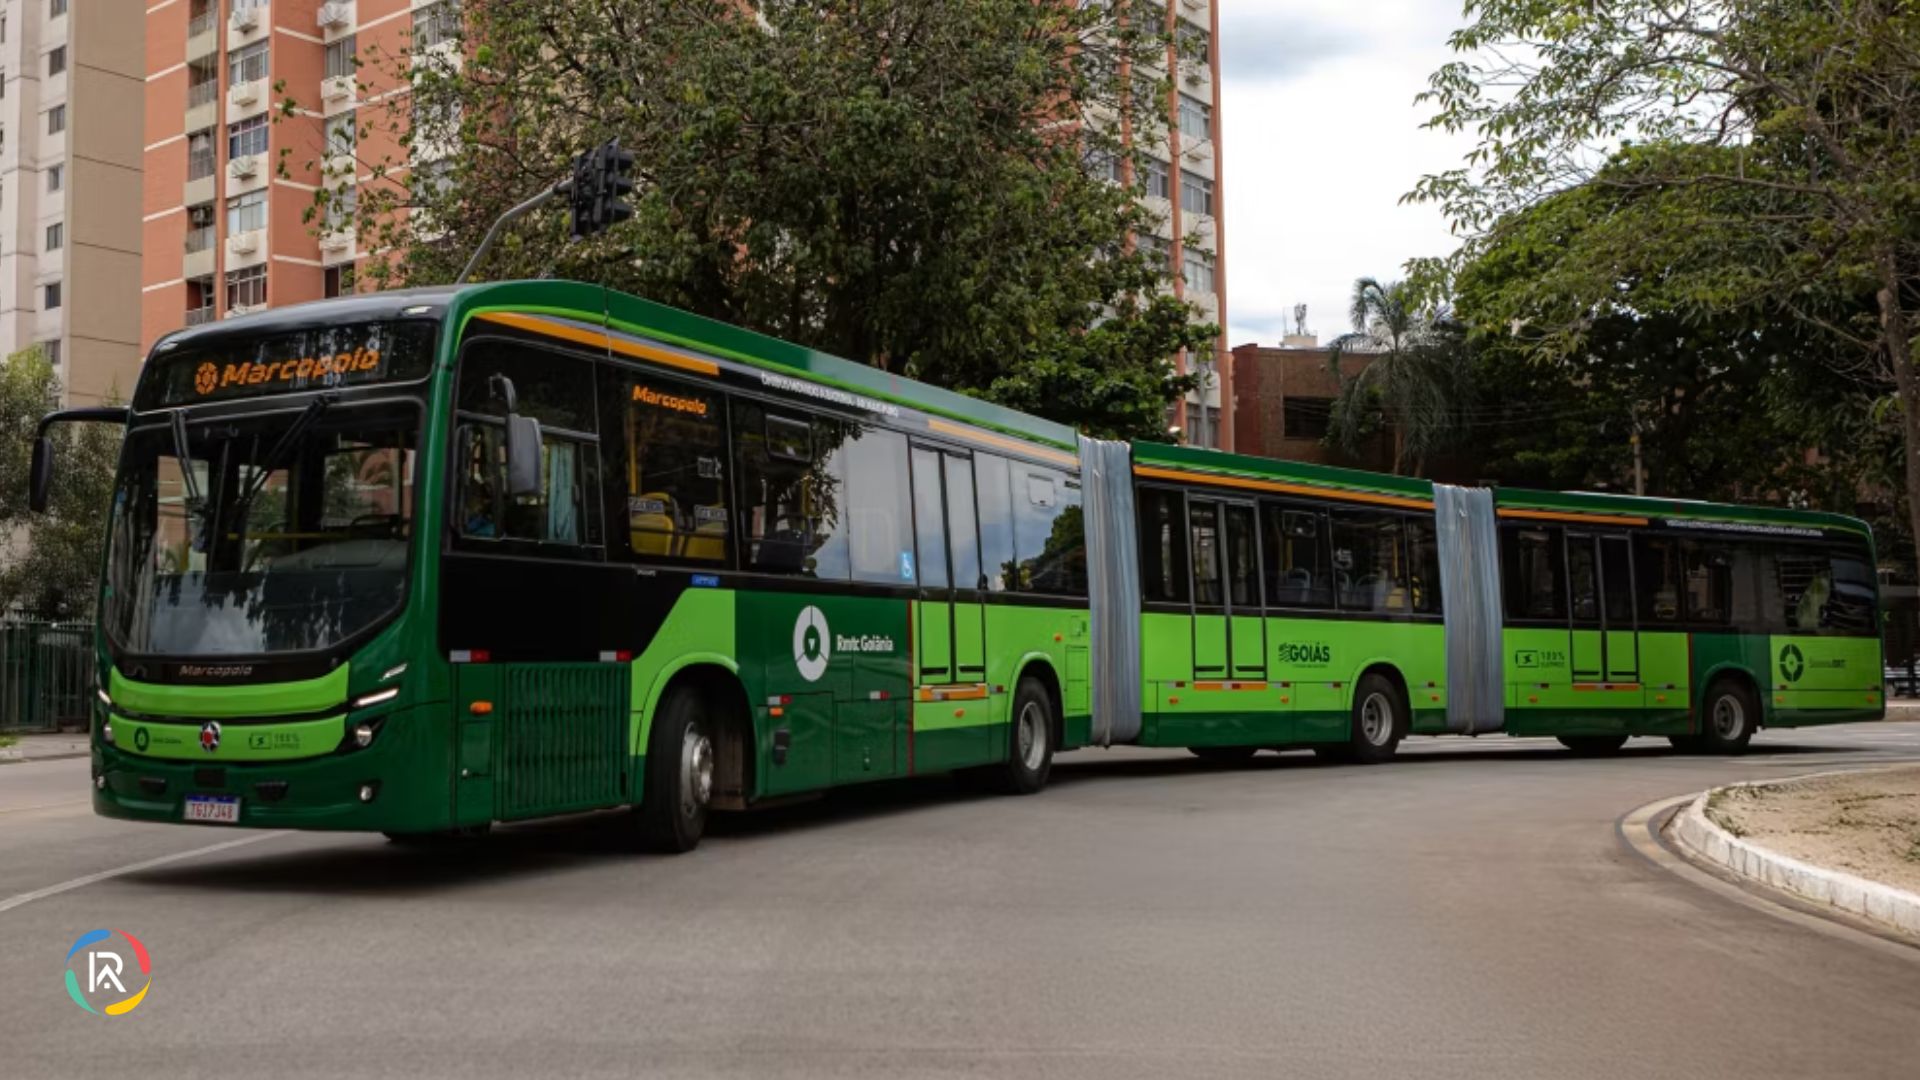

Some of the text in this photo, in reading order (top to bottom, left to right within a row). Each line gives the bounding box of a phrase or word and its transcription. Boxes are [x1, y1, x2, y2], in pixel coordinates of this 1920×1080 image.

[220, 345, 380, 387] Marcopolo
[633, 385, 706, 415] Marcopolo
[837, 634, 893, 651] Rmtc Goiânia
[1290, 642, 1330, 662] GOIÁS
[179, 664, 253, 678] Marcopolo
